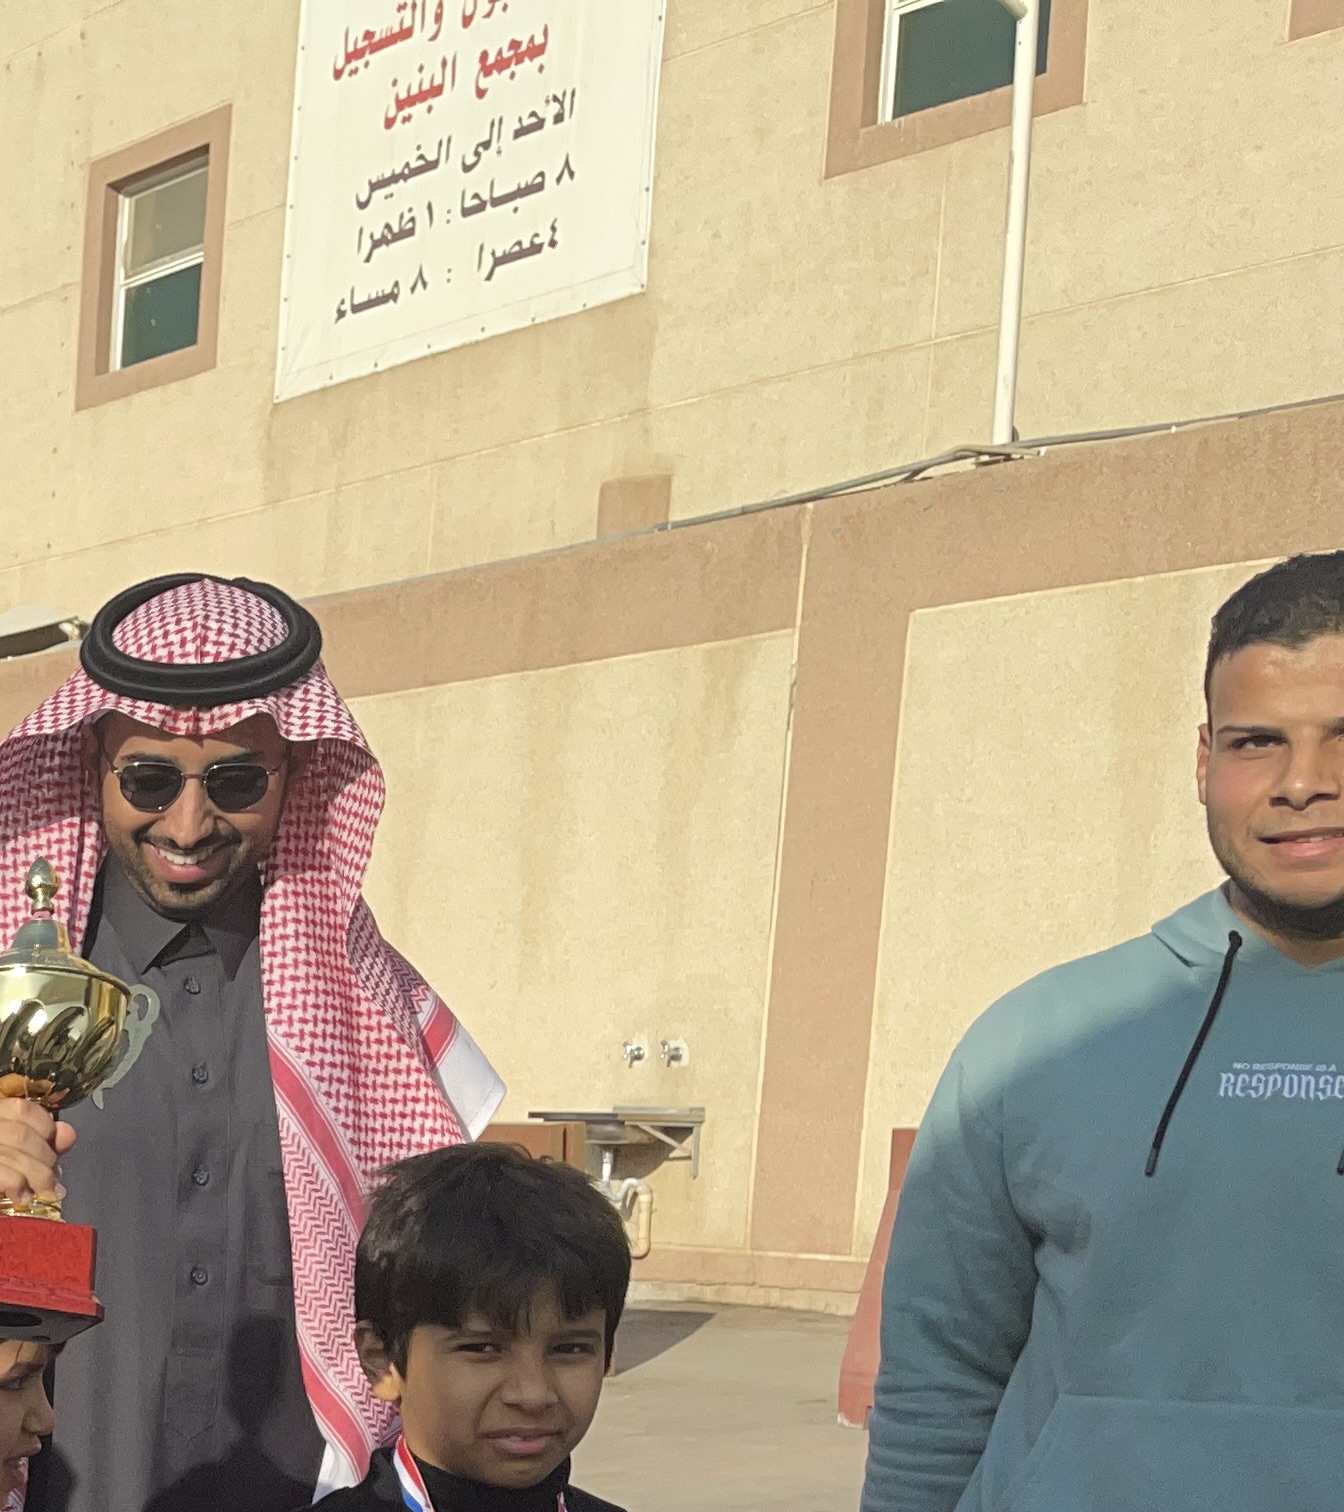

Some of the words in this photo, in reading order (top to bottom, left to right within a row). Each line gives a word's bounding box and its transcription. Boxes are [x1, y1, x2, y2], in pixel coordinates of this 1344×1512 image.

[333, 0, 444, 81] والتسجيل
[475, 23, 549, 99] بمجمع
[384, 50, 458, 130] البنين
[461, 115, 504, 173] إلى
[556, 152, 576, 186] ٨
[355, 135, 452, 211] الخميس
[460, 170, 546, 218] صباحا
[357, 206, 417, 263] ظهرا
[426, 200, 434, 228] ١
[334, 279, 401, 325] مساء
[410, 263, 428, 295] ٨
